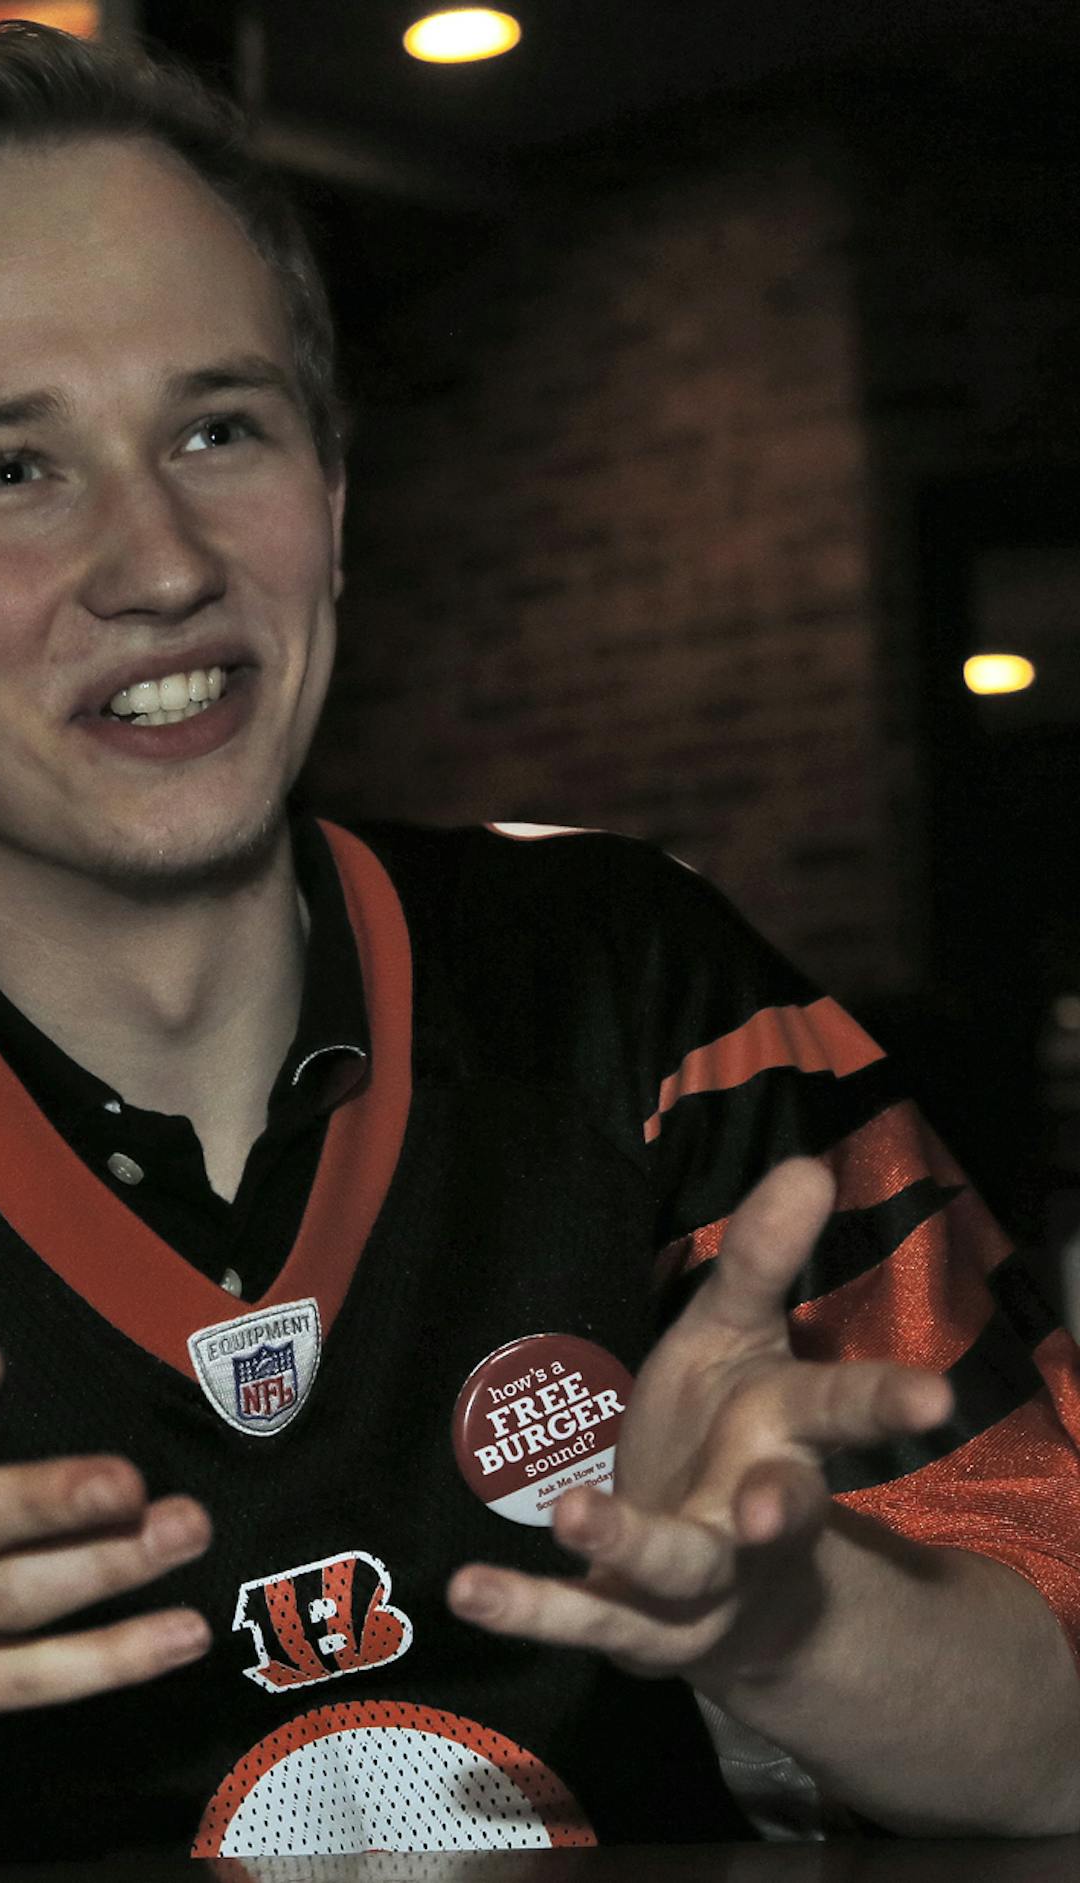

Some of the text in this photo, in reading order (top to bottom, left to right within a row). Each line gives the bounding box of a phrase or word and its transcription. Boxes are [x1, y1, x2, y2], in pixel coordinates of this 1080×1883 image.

[207, 1315, 311, 1362] EQUIPMENT
[241, 1375, 295, 1416] NFL
[486, 1371, 590, 1439] FREE
[487, 1360, 566, 1404] how's a
[473, 1388, 627, 1476] BURGER
[524, 1431, 597, 1478] sound?
[538, 1462, 606, 1497] Ask Me How to
